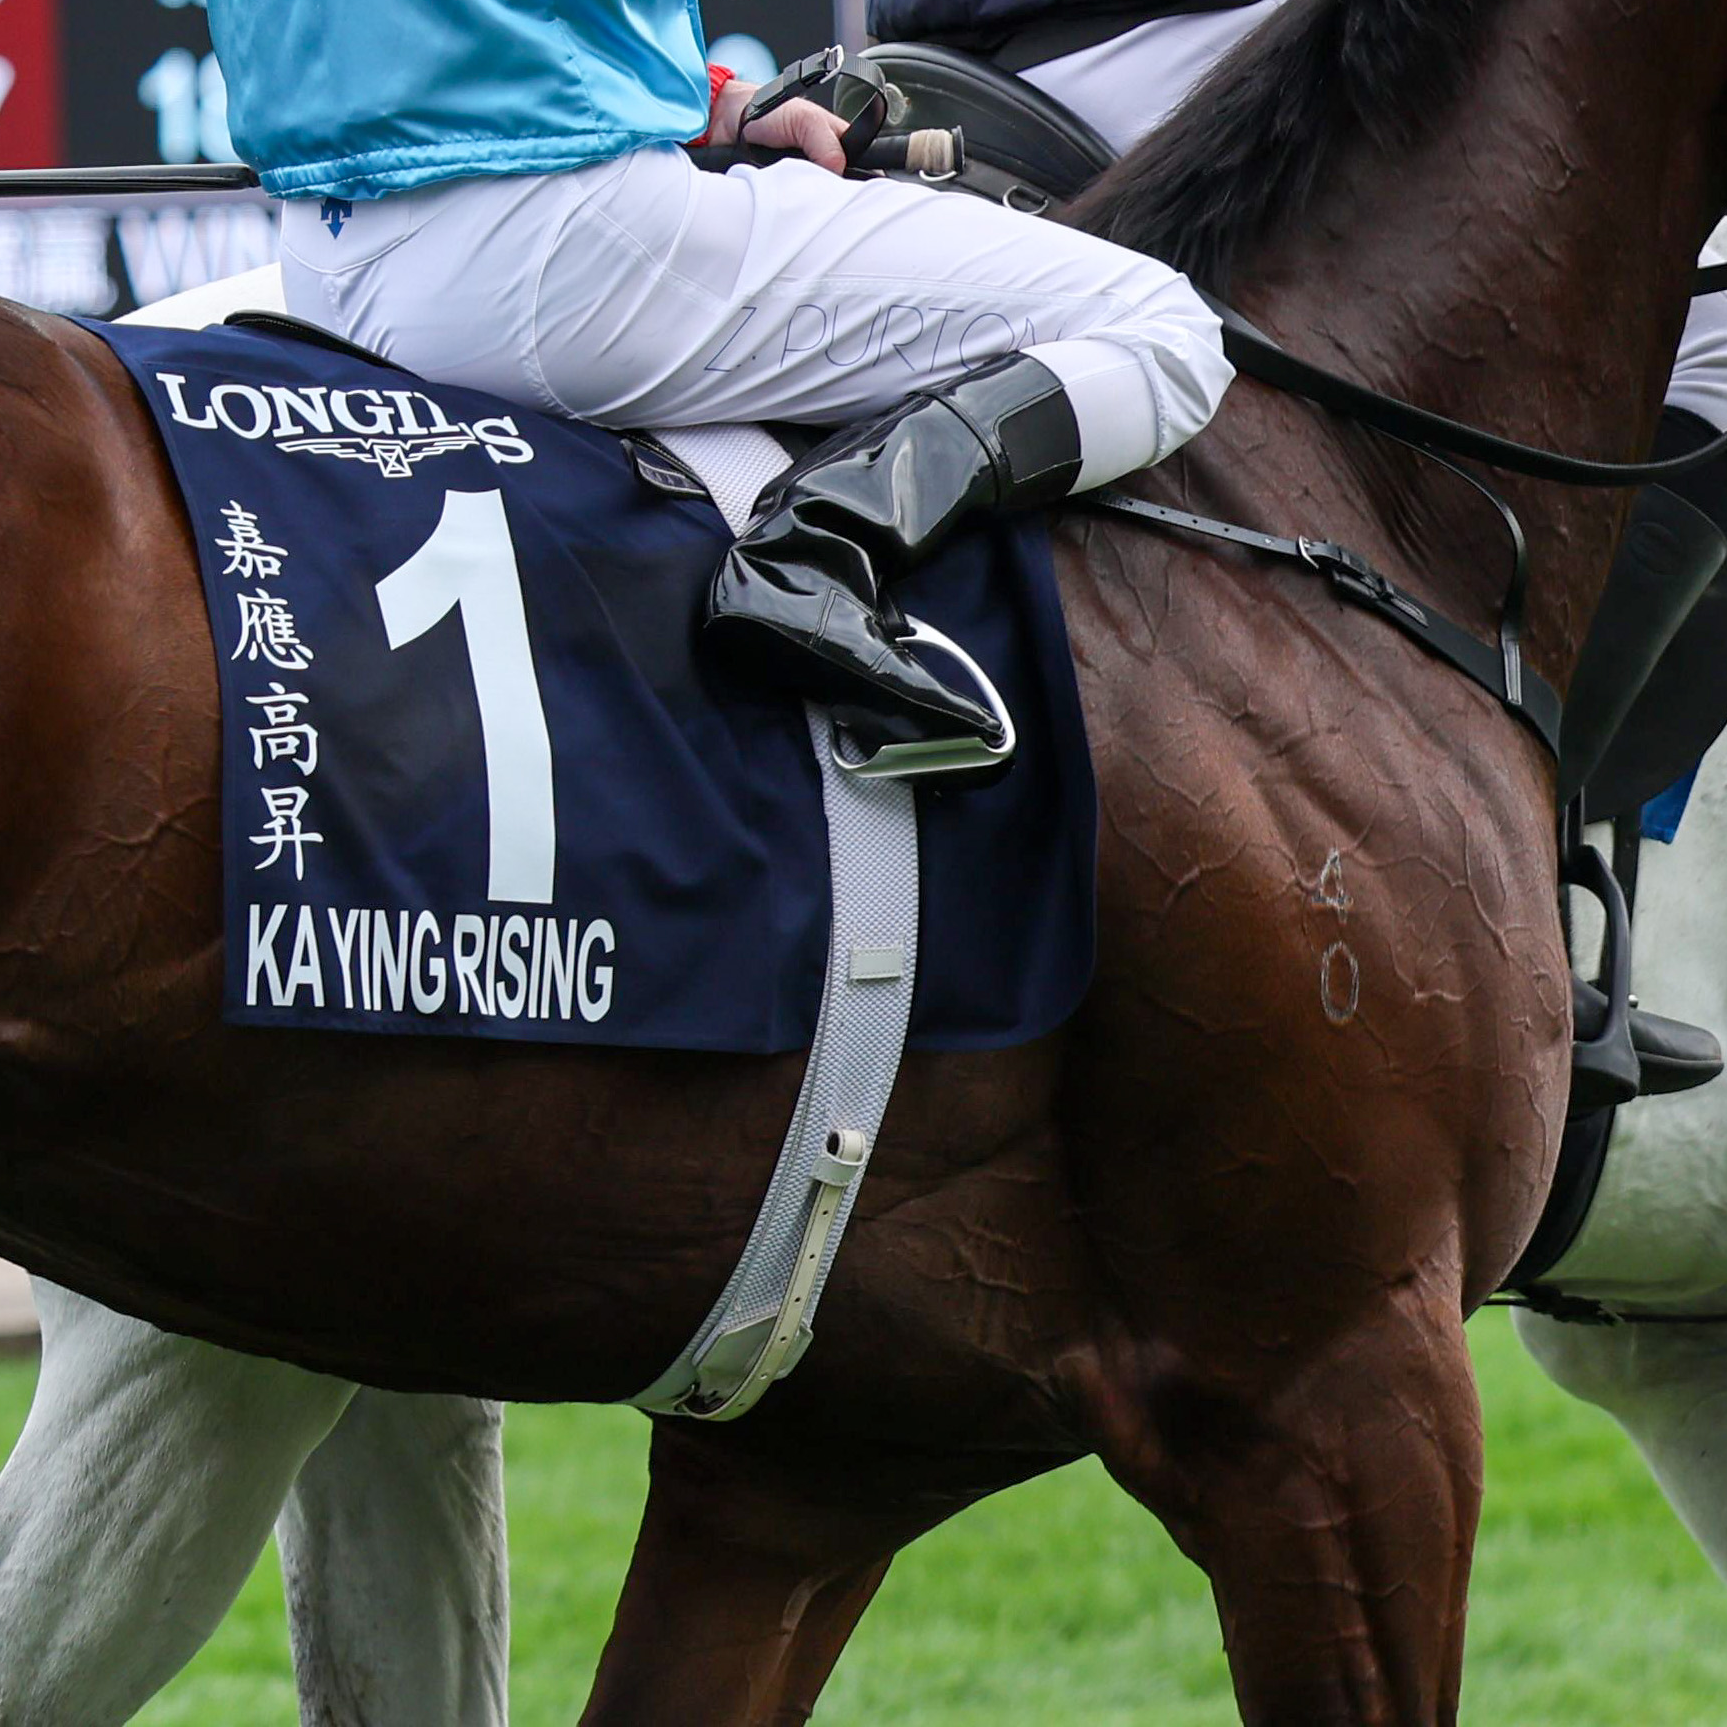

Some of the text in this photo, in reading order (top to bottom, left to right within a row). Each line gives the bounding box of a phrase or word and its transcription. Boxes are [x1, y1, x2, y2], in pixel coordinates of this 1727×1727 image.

[703, 305, 757, 372] Z.
[156, 372, 535, 465] LONGIS
[214, 499, 325, 882] 嘉應高昇
[374, 488, 556, 905] 1
[245, 903, 616, 1023] KA YING RISING
